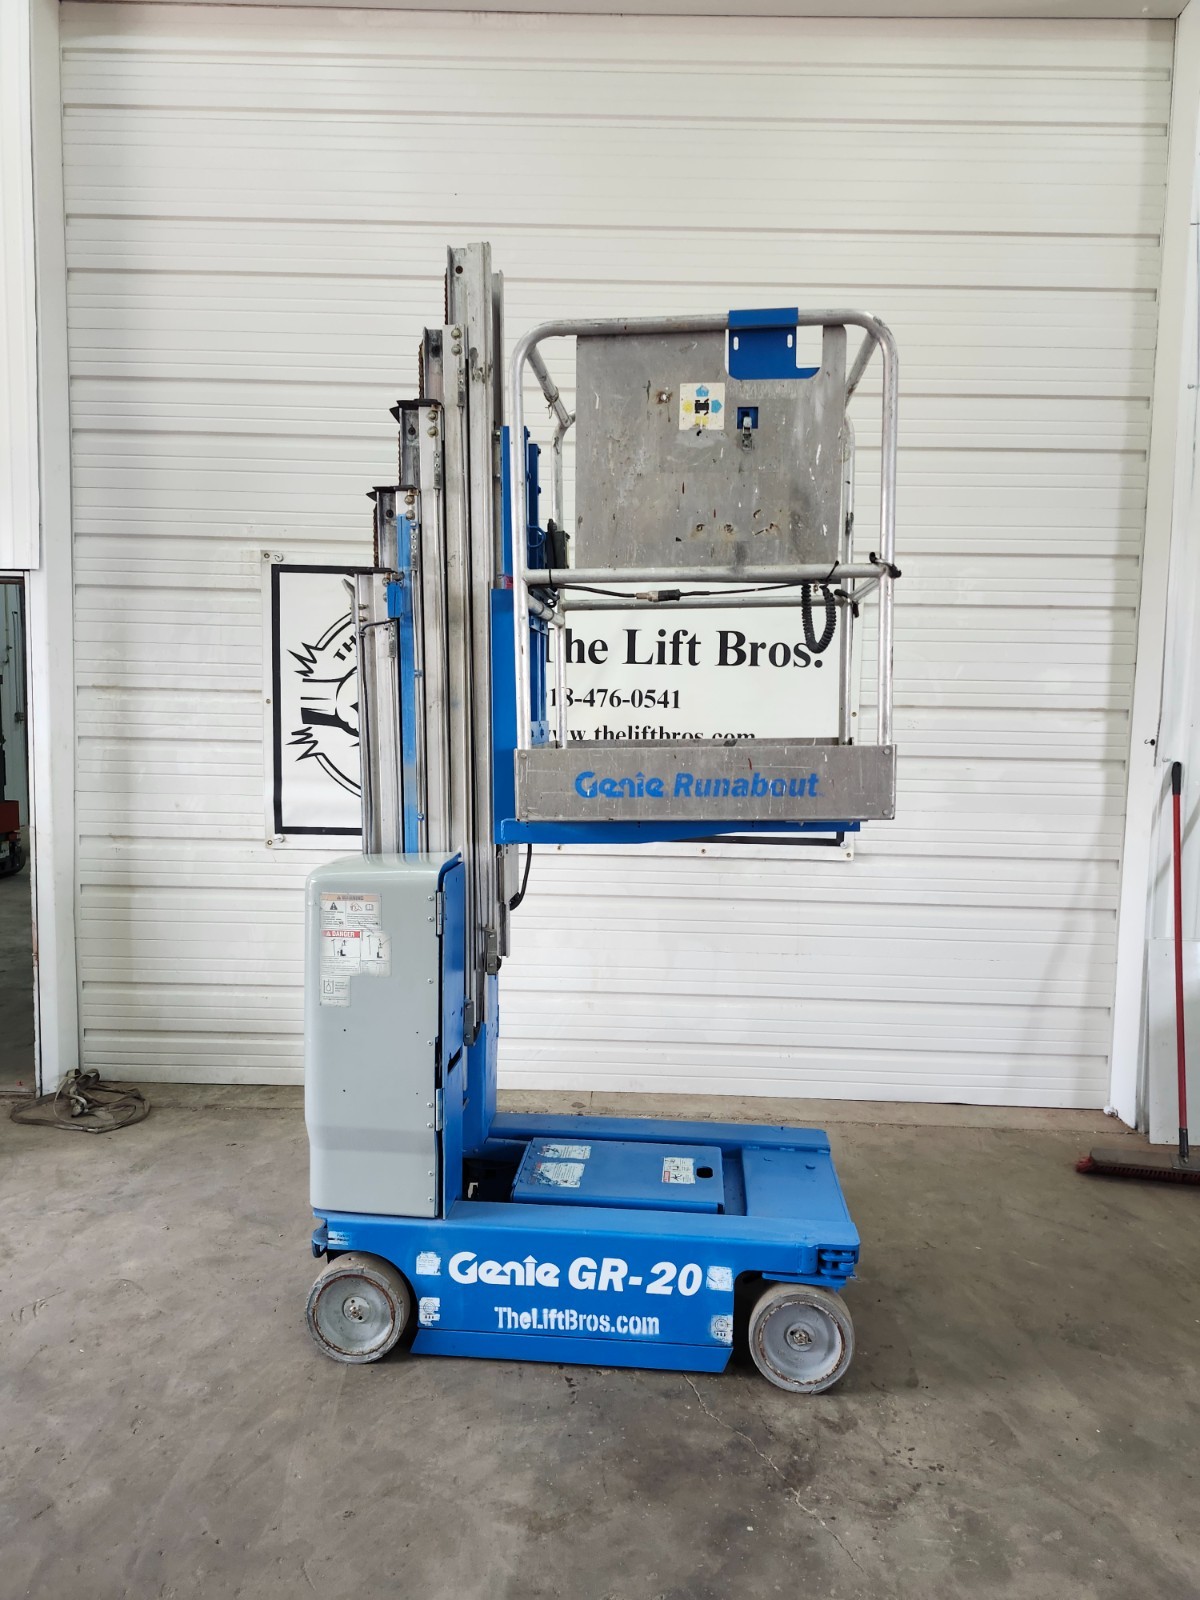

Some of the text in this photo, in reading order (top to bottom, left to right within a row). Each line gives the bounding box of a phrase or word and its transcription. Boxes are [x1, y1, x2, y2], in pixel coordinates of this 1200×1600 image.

[333, 634, 356, 662] TH
[622, 628, 701, 667] Lift
[715, 630, 823, 668] Bros.
[548, 687, 680, 709] 18-476-0541
[574, 771, 820, 798] Genie Runabout
[448, 1251, 561, 1287] Genie
[568, 1256, 703, 1297] GR-20
[494, 1306, 660, 1335] TheLiftBros.com
